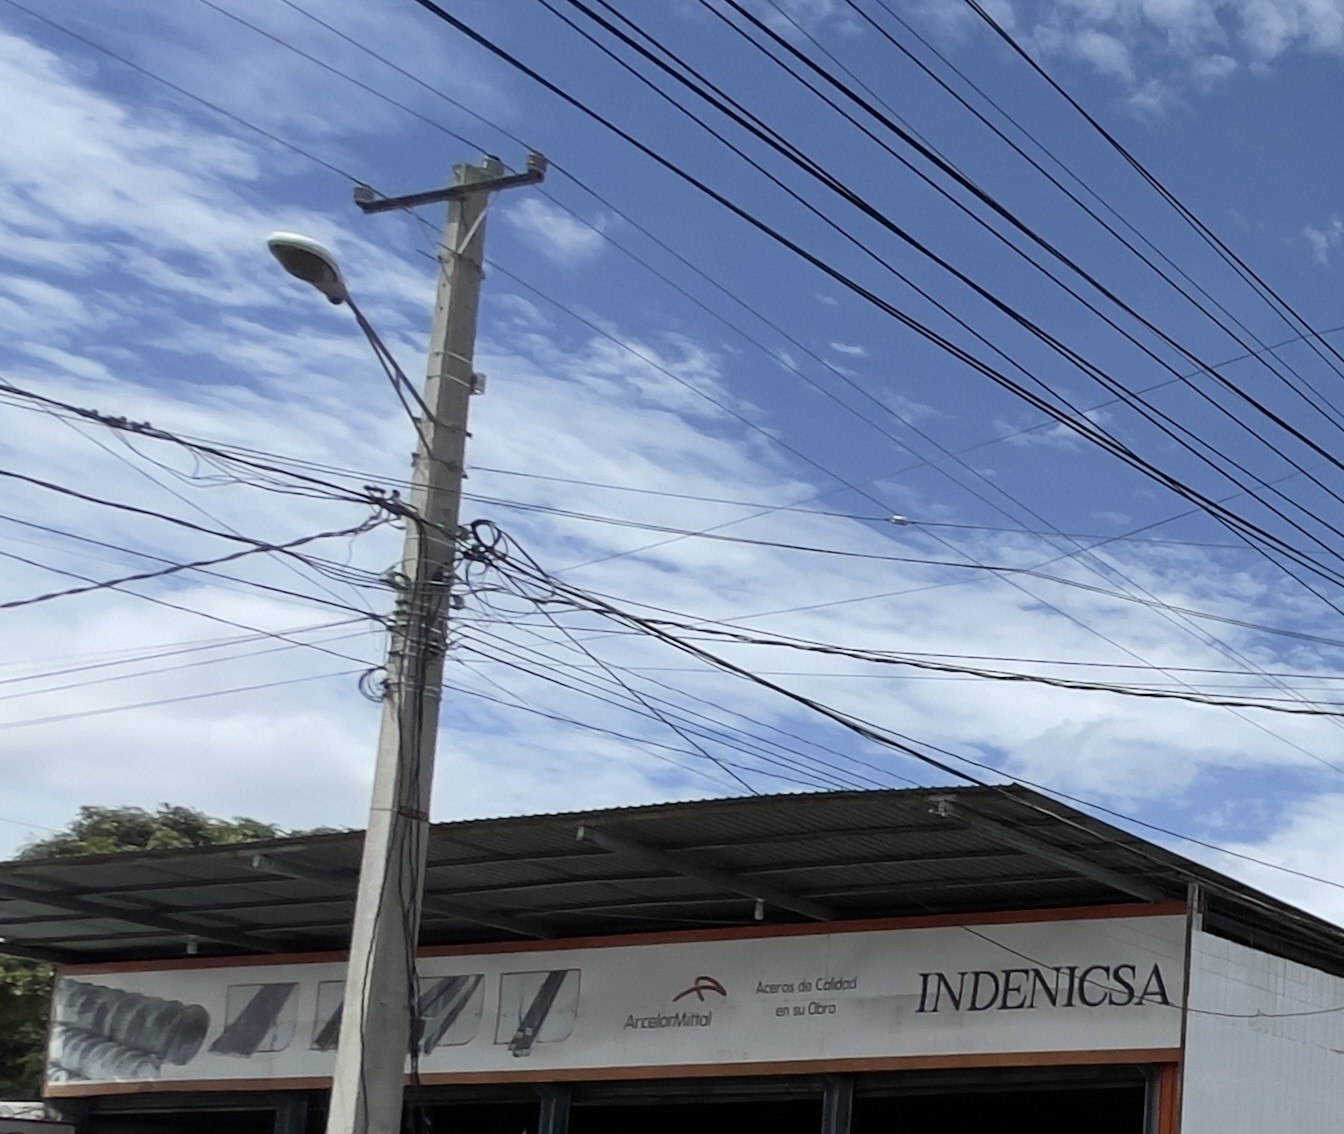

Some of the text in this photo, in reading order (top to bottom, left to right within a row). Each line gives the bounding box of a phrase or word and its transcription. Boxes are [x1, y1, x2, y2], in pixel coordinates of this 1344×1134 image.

[755, 976, 857, 995] Aceros de Calidad
[915, 962, 1171, 1013] INDENICSA
[775, 1001, 836, 1017] en su Obra
[623, 1011, 712, 1029] ArcelorMittal
